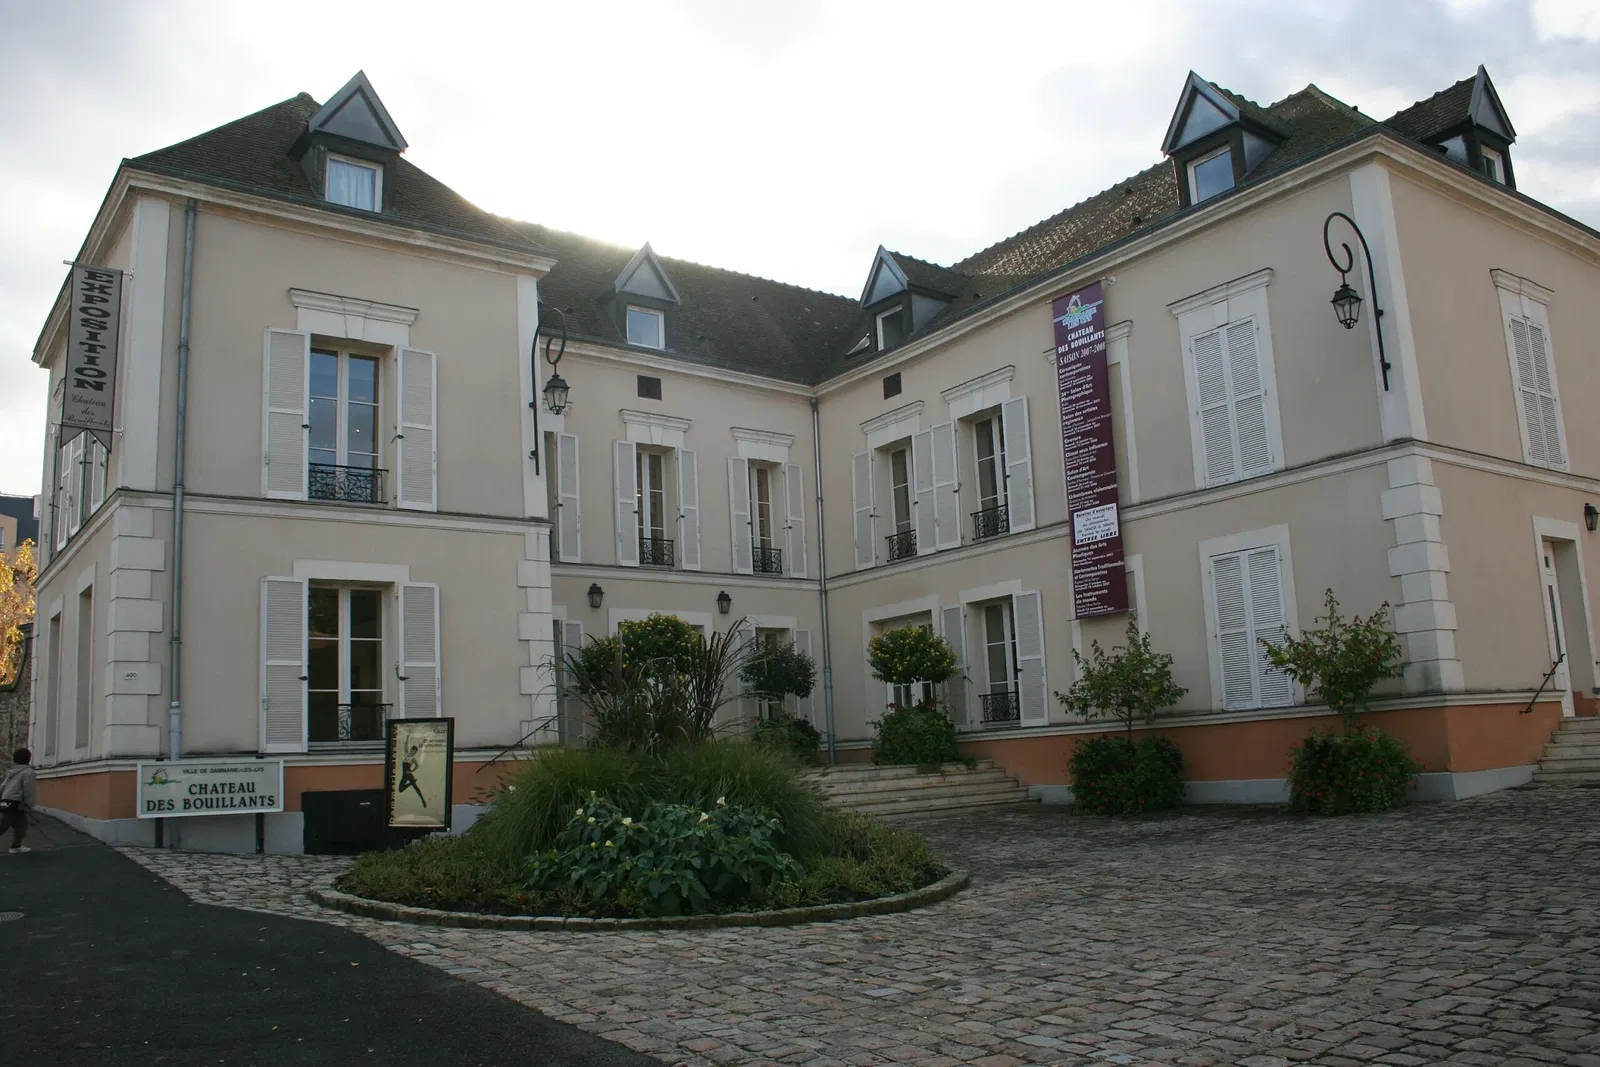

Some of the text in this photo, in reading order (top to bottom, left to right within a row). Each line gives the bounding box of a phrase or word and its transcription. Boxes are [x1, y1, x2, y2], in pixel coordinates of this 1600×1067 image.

[74, 270, 114, 392] EXPOSITION
[1068, 326, 1094, 341] CHATEAU
[1059, 330, 1105, 354] DES BOUILLANTS
[1060, 342, 1106, 366] SAISON 2007-2008
[82, 408, 95, 416] des
[1089, 442, 1108, 451] influence
[188, 782, 255, 795] CHATEAU
[146, 795, 275, 812] DES BOUILLANTS
